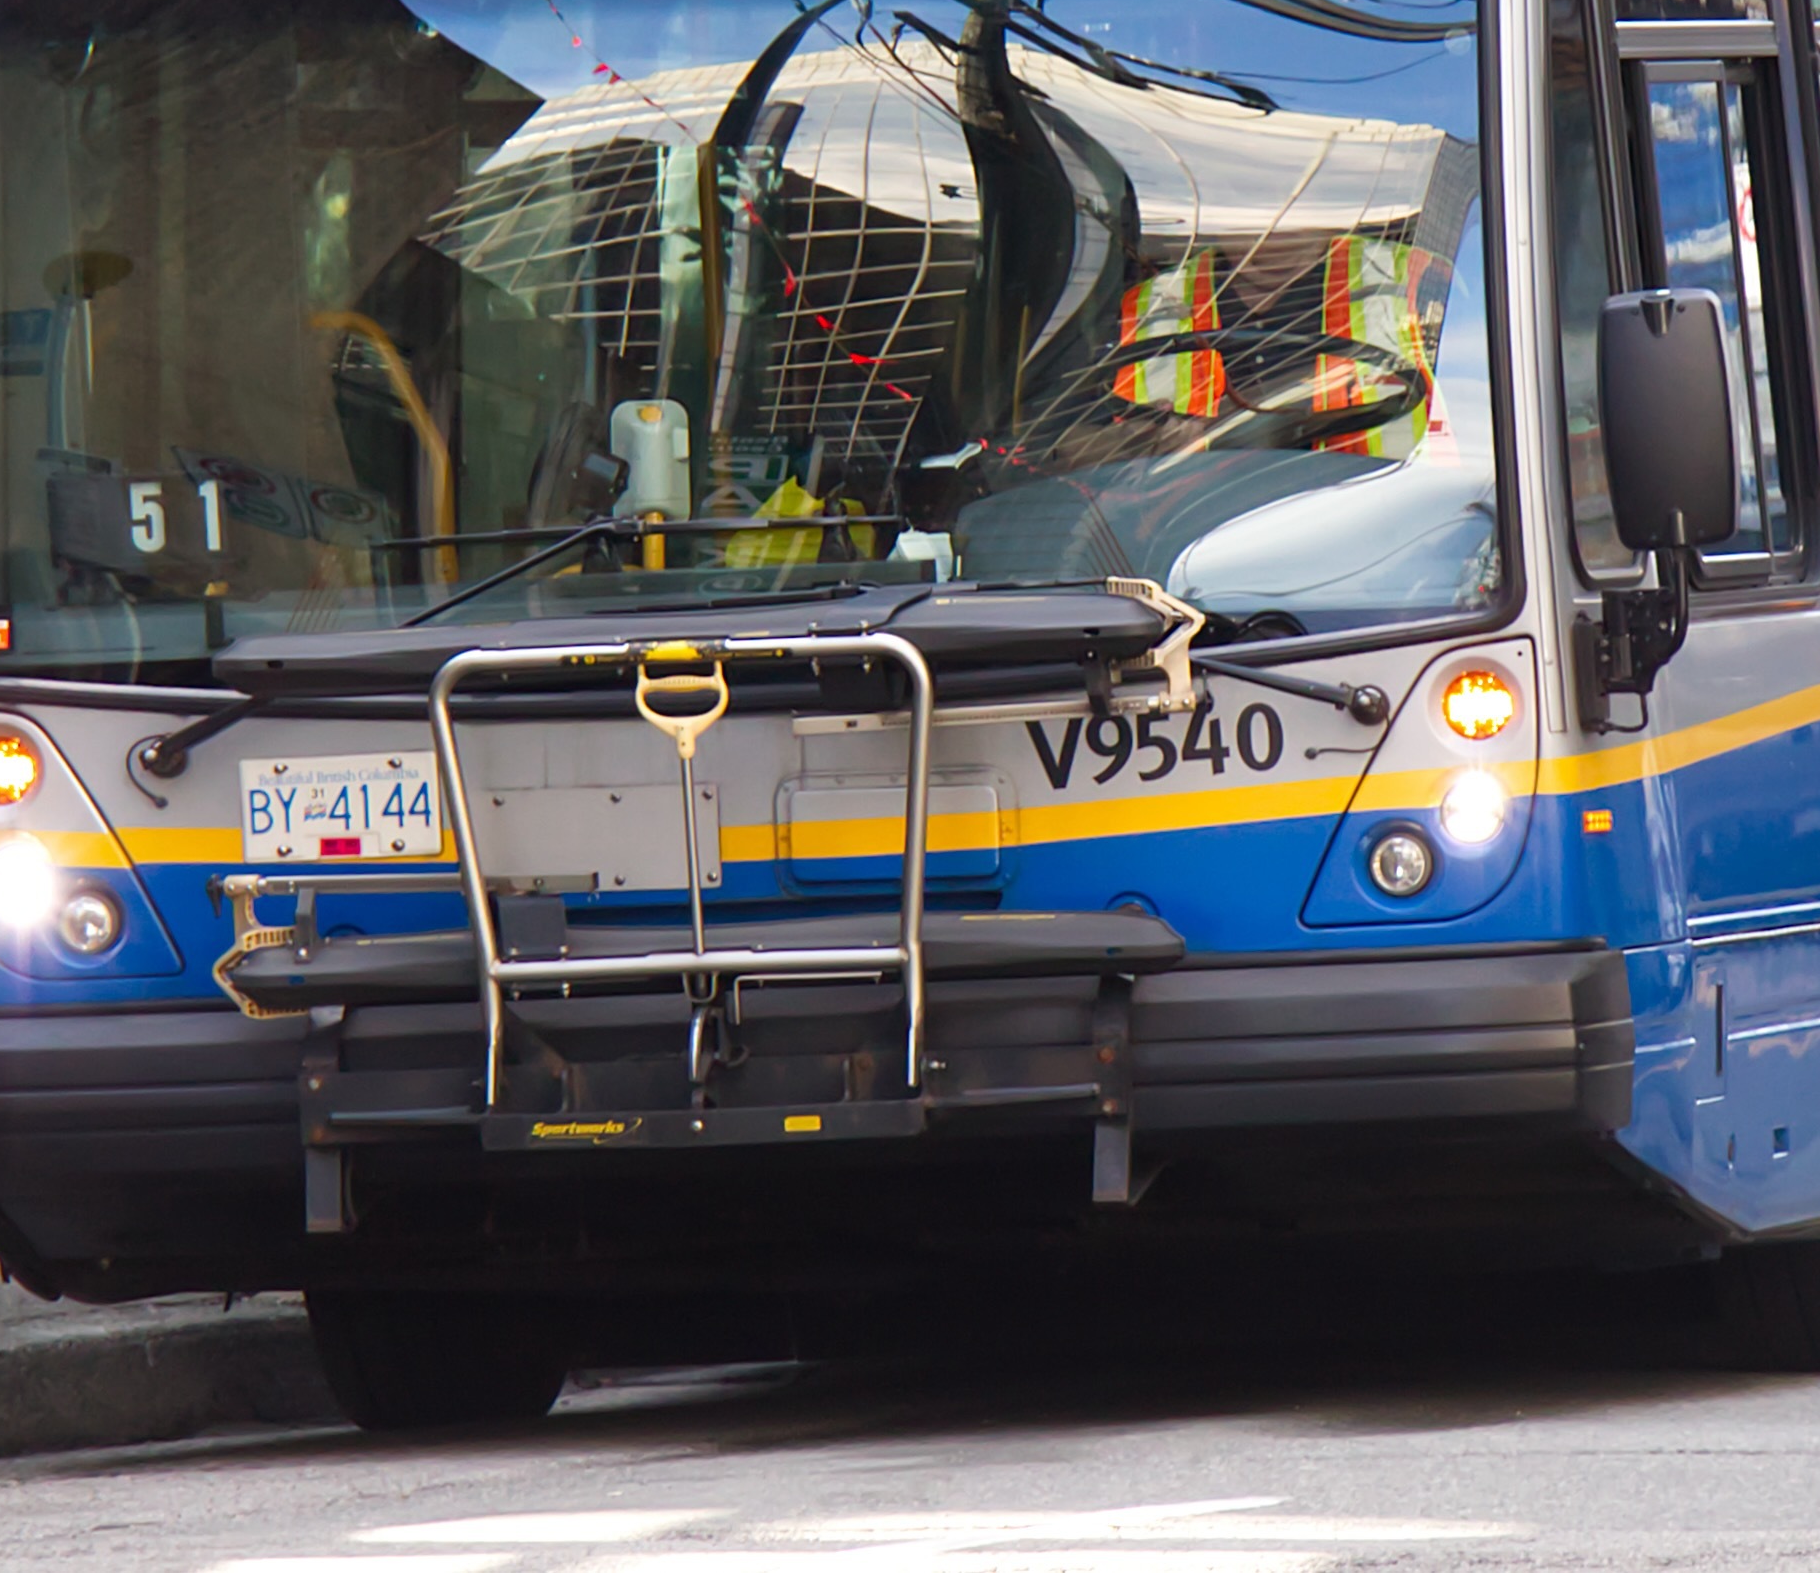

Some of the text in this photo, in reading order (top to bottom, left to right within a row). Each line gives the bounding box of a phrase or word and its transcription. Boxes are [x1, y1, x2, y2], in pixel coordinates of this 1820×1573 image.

[1026, 702, 1284, 790] V9540
[249, 781, 431, 834] BY 4144
[311, 788, 325, 798] 31
[531, 1120, 626, 1138] Sportworks
